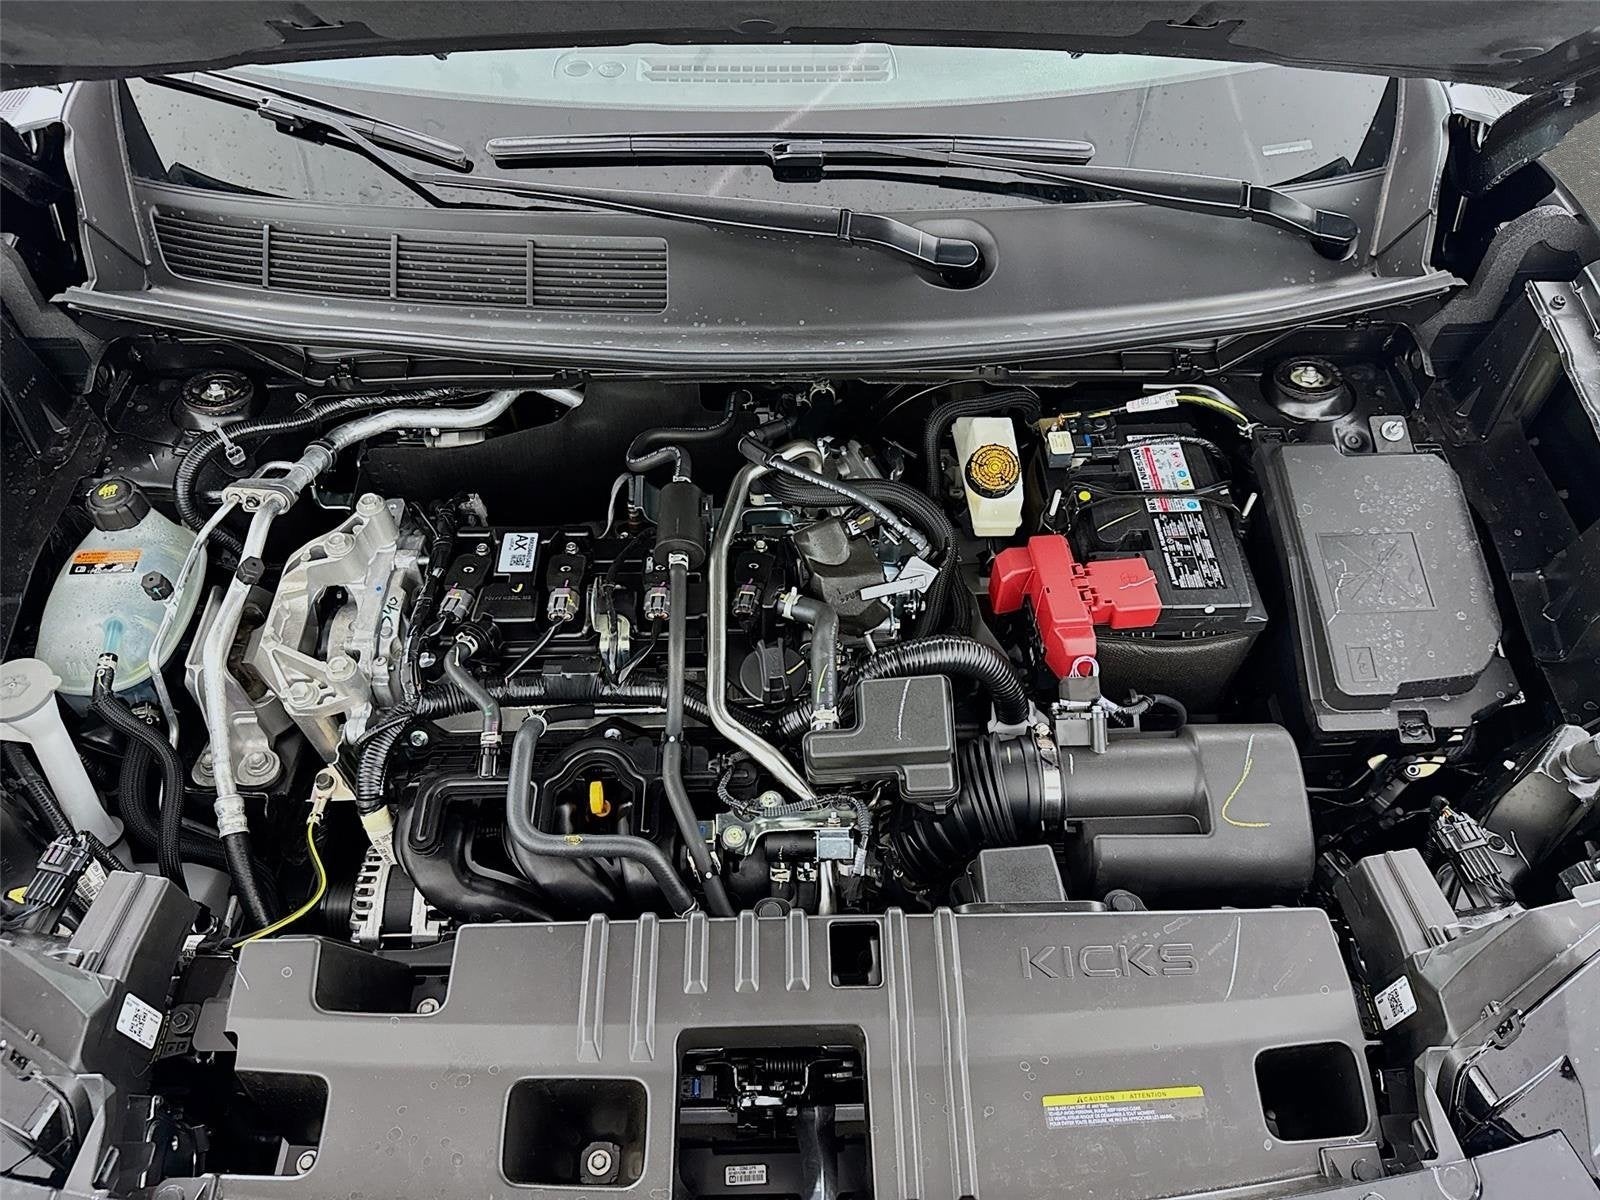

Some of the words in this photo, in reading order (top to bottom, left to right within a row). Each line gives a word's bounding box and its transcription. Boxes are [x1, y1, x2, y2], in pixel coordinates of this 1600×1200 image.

[1132, 447, 1149, 481] NISSAN
[514, 534, 529, 550] AX
[1020, 943, 1200, 979] KICKS
[1129, 1091, 1167, 1099] ATTENTION
